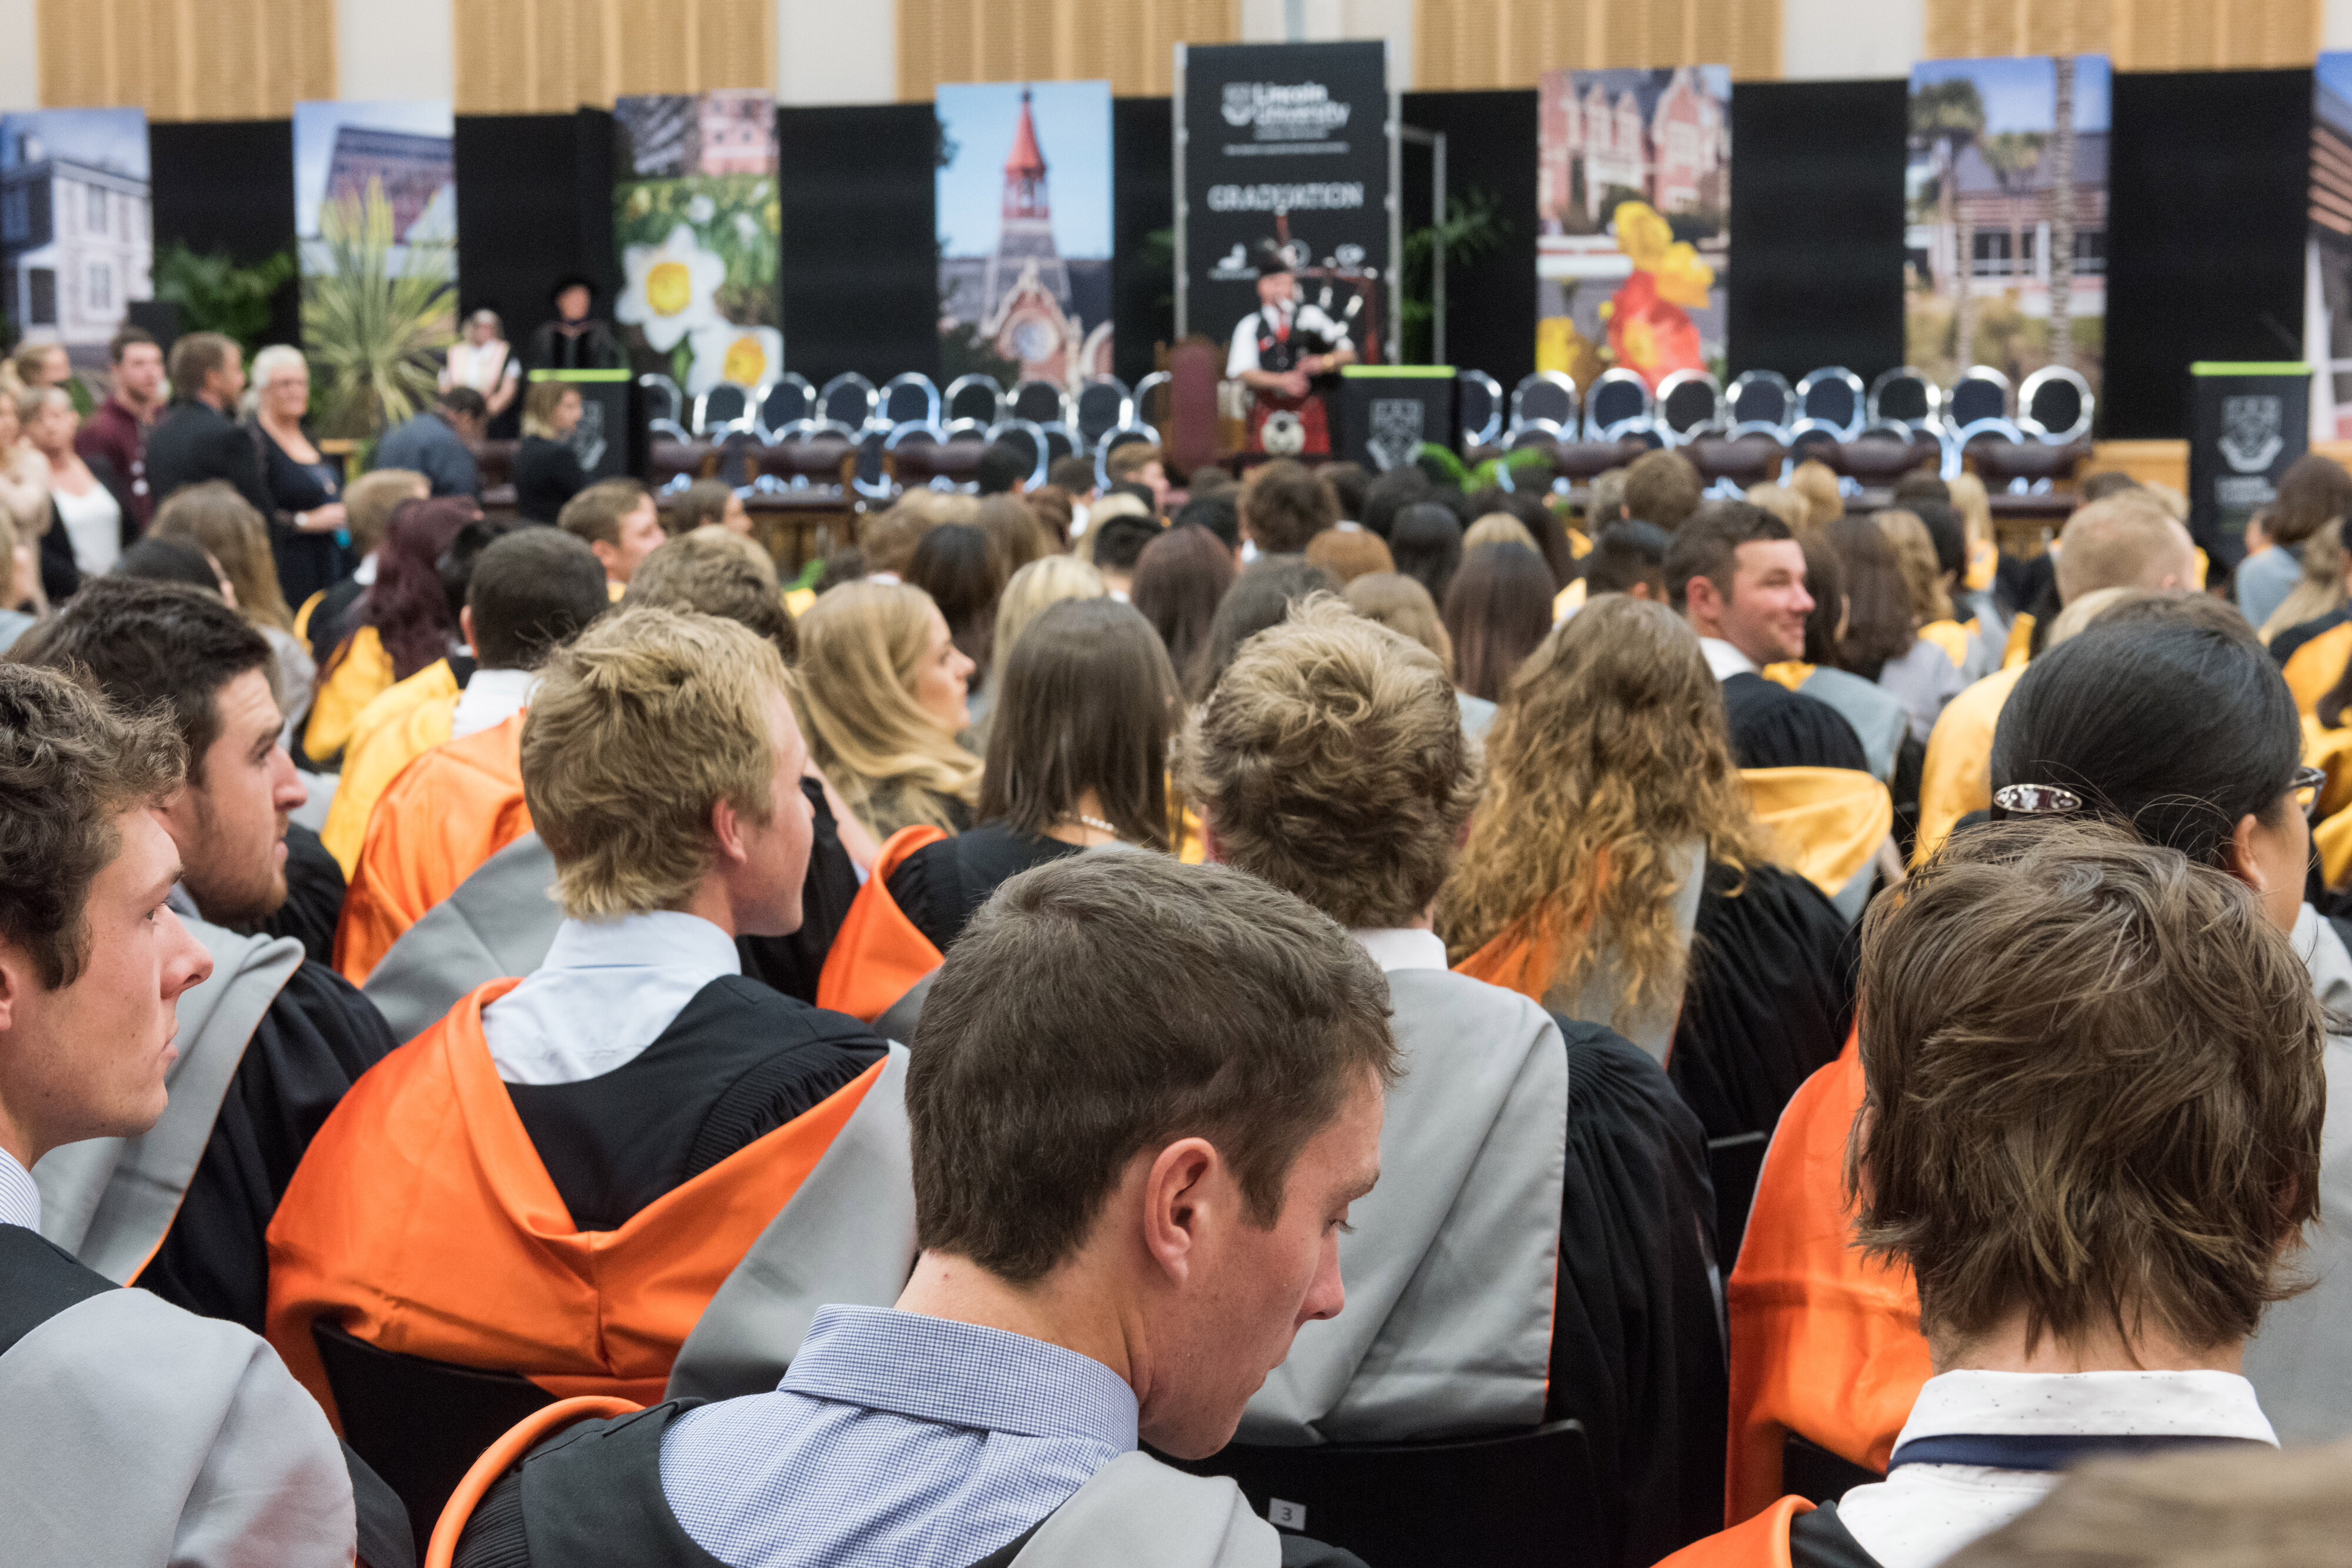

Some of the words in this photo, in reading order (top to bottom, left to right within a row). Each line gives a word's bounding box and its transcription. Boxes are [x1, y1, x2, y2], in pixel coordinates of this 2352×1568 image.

[1254, 82, 1327, 105] Lincoln
[1254, 102, 1350, 128] University
[1207, 183, 1364, 211] GRADUATION
[1282, 1507, 1292, 1522] 3
